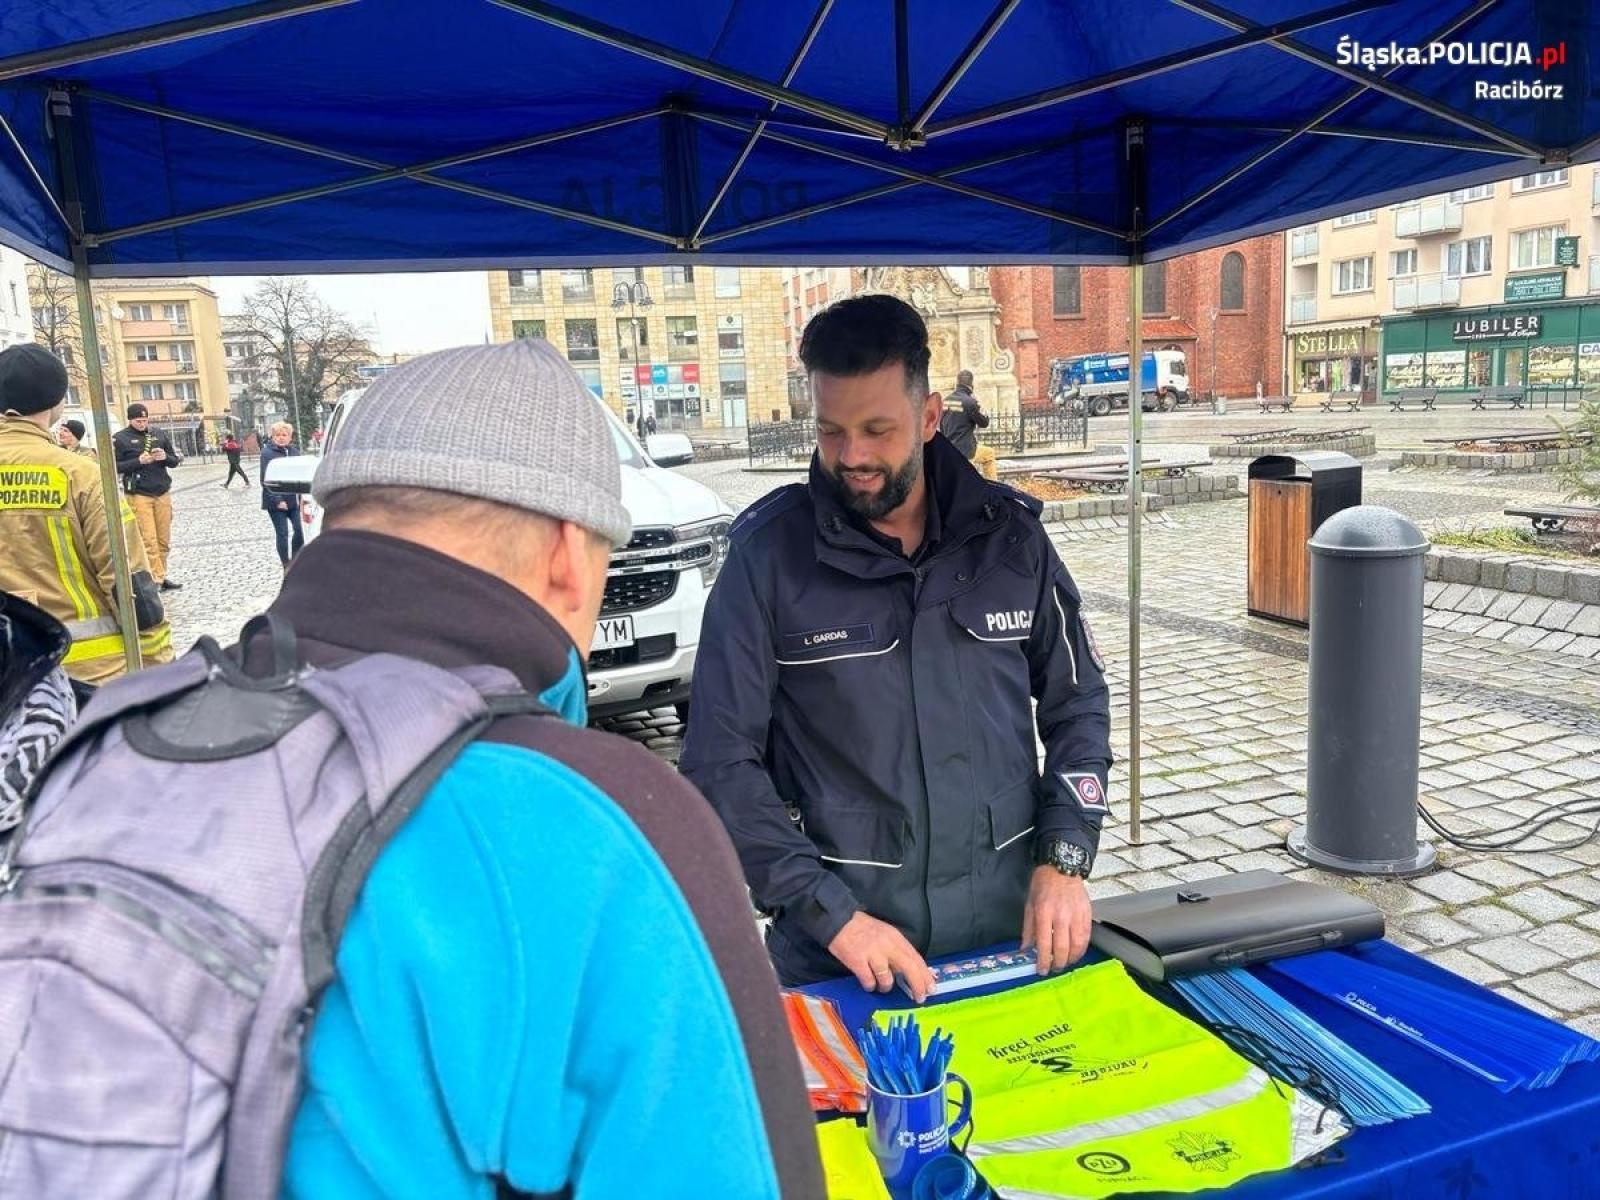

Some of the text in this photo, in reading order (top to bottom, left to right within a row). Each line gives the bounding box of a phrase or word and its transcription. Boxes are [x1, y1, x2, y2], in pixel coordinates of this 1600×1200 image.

[1454, 316, 1538, 334] JUBILER
[1298, 334, 1358, 354] STELLA
[595, 620, 628, 642] YM
[986, 610, 1034, 632] POLICJ
[813, 630, 848, 643] GARDAS
[1034, 1023, 1073, 1043] mnie
